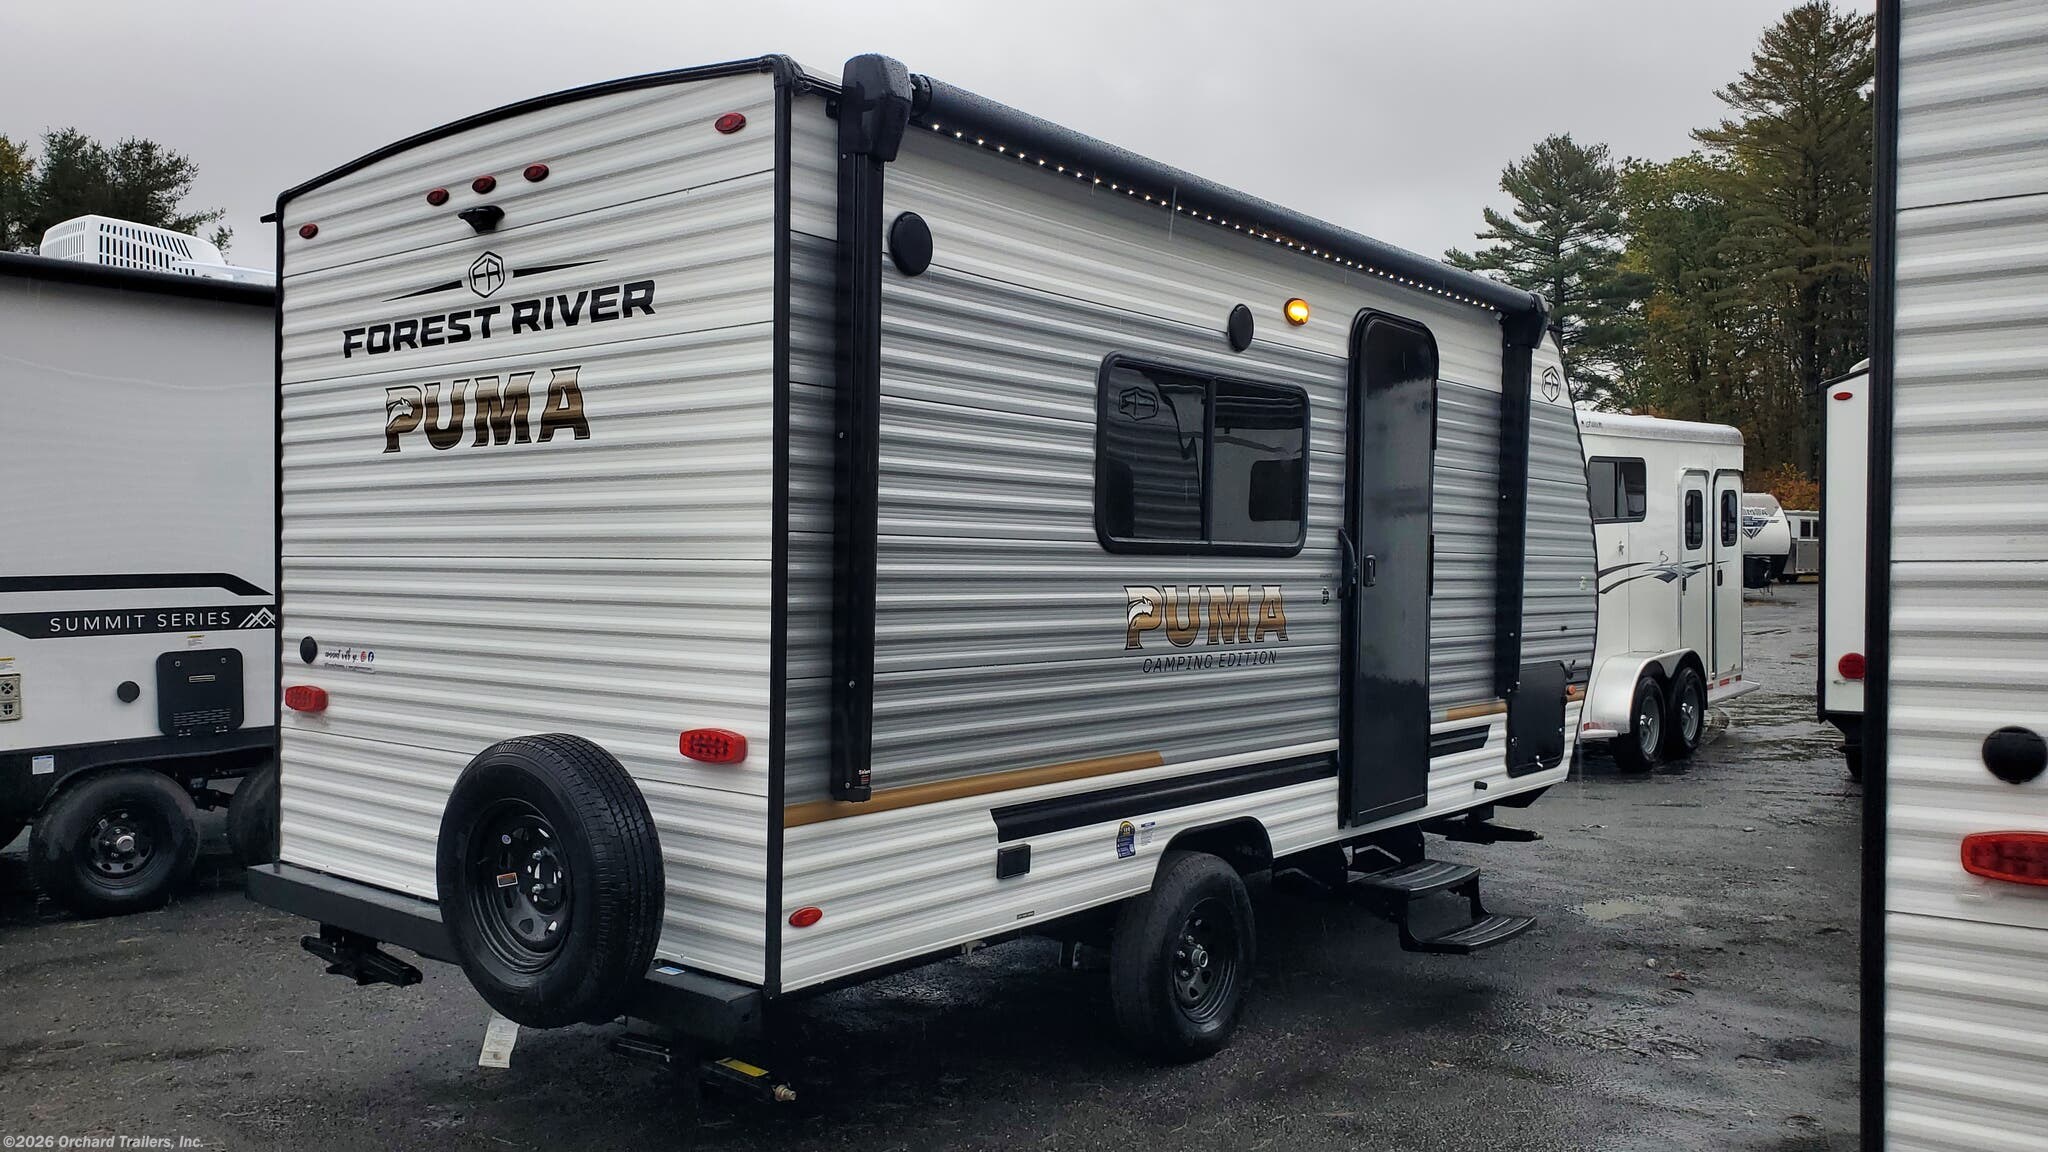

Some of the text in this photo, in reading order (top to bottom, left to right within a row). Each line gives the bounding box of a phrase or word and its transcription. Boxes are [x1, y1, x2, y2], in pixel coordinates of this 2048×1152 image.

[342, 279, 657, 358] FOREST RIVER
[382, 364, 591, 454] PUMA
[50, 611, 231, 632] SUMMIT SERIES
[1123, 584, 1289, 651] PUMA
[1142, 650, 1278, 673] CAMPING EDITION
